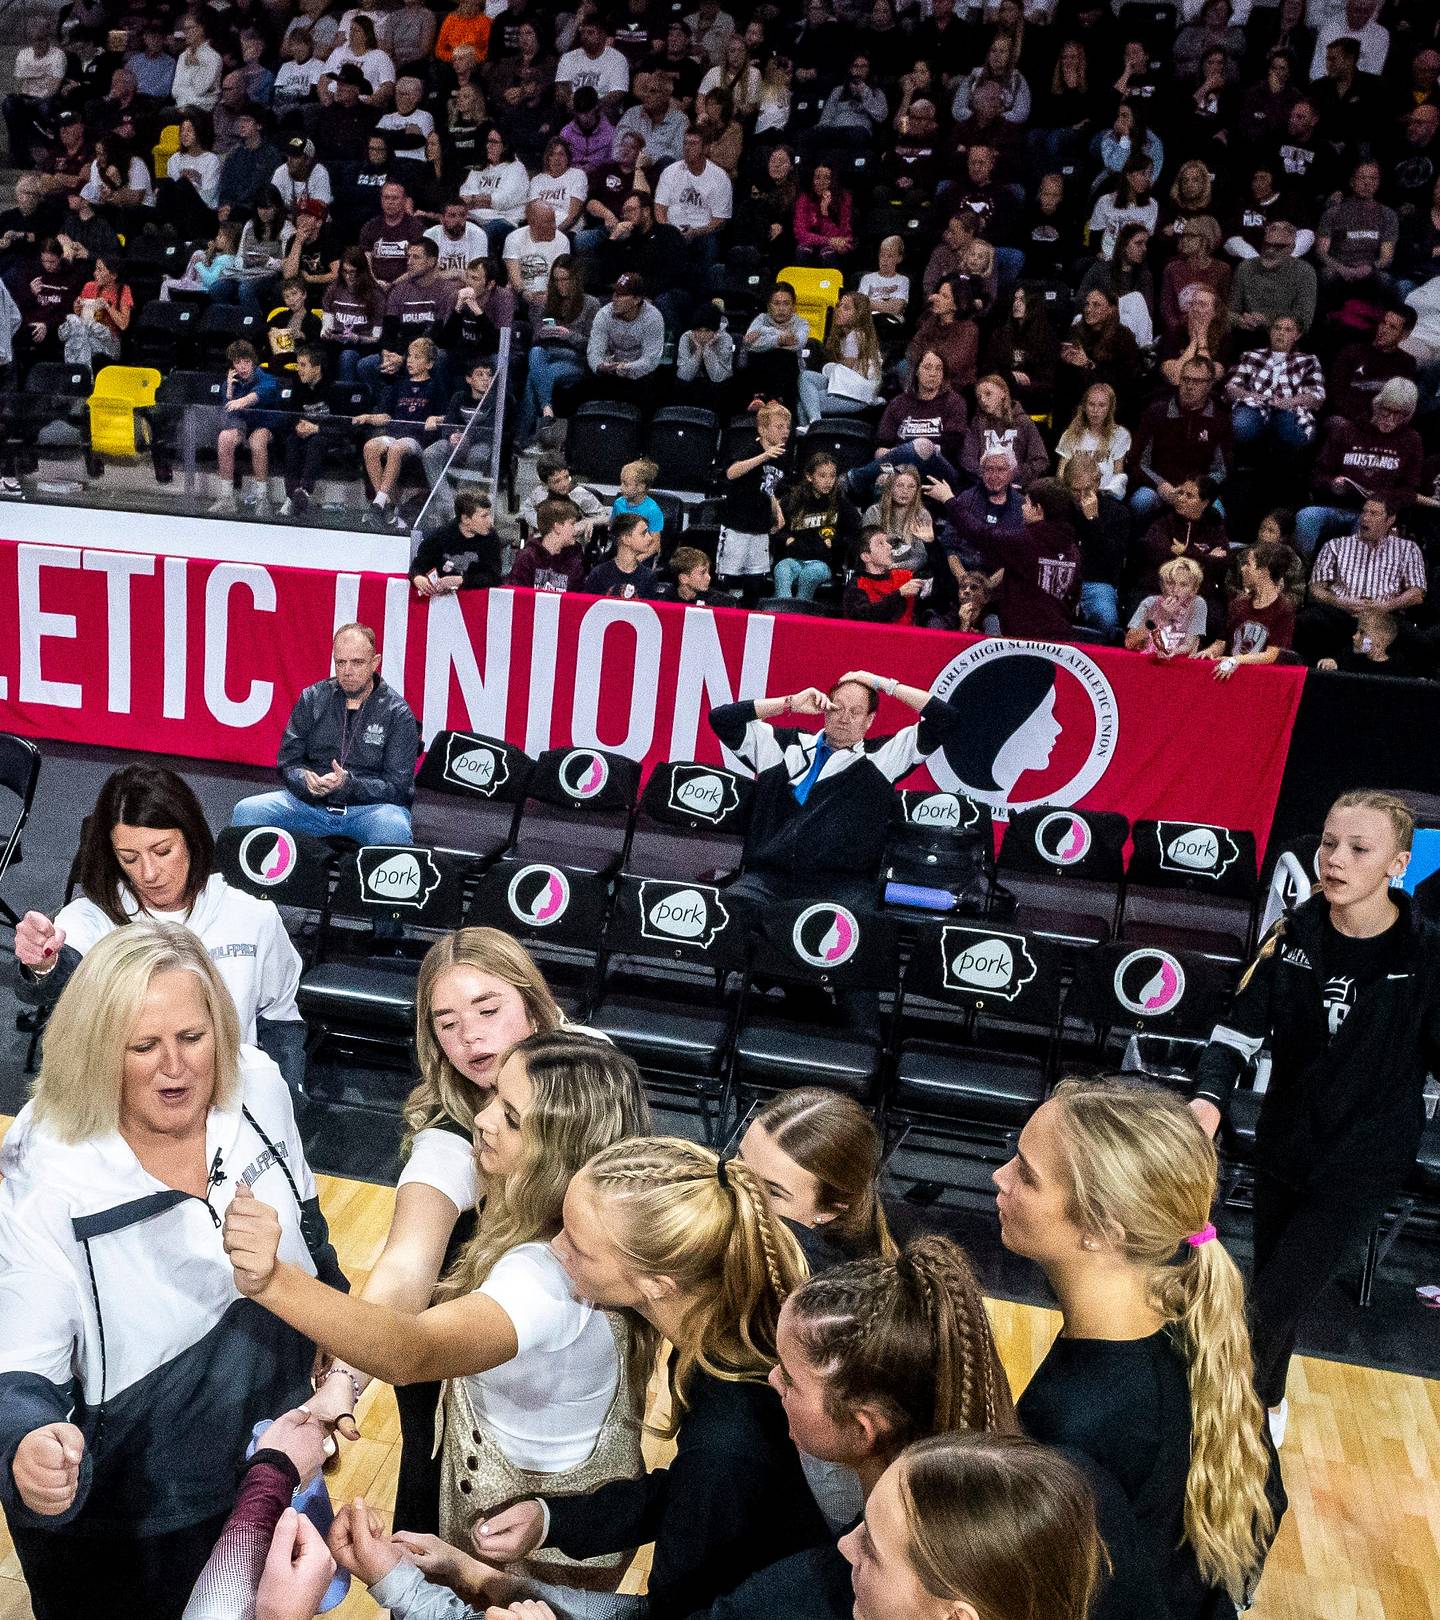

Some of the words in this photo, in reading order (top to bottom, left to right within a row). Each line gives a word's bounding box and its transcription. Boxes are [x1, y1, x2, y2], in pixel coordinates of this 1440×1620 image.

[1343, 452, 1401, 471] MUSTANGS
[331, 572, 776, 777] UNION
[937, 661, 969, 695] GIRLS
[970, 641, 1004, 663] HIGH
[1009, 640, 1064, 658] SCHOOL
[1066, 654, 1110, 711] ATHLETIC
[1097, 714, 1112, 758] UNION
[455, 755, 493, 777] pork
[681, 782, 721, 804] pork
[917, 803, 958, 821] pork
[1172, 839, 1217, 858] pork
[374, 866, 418, 888] pork
[656, 903, 705, 925] pork
[959, 951, 1011, 976] pork
